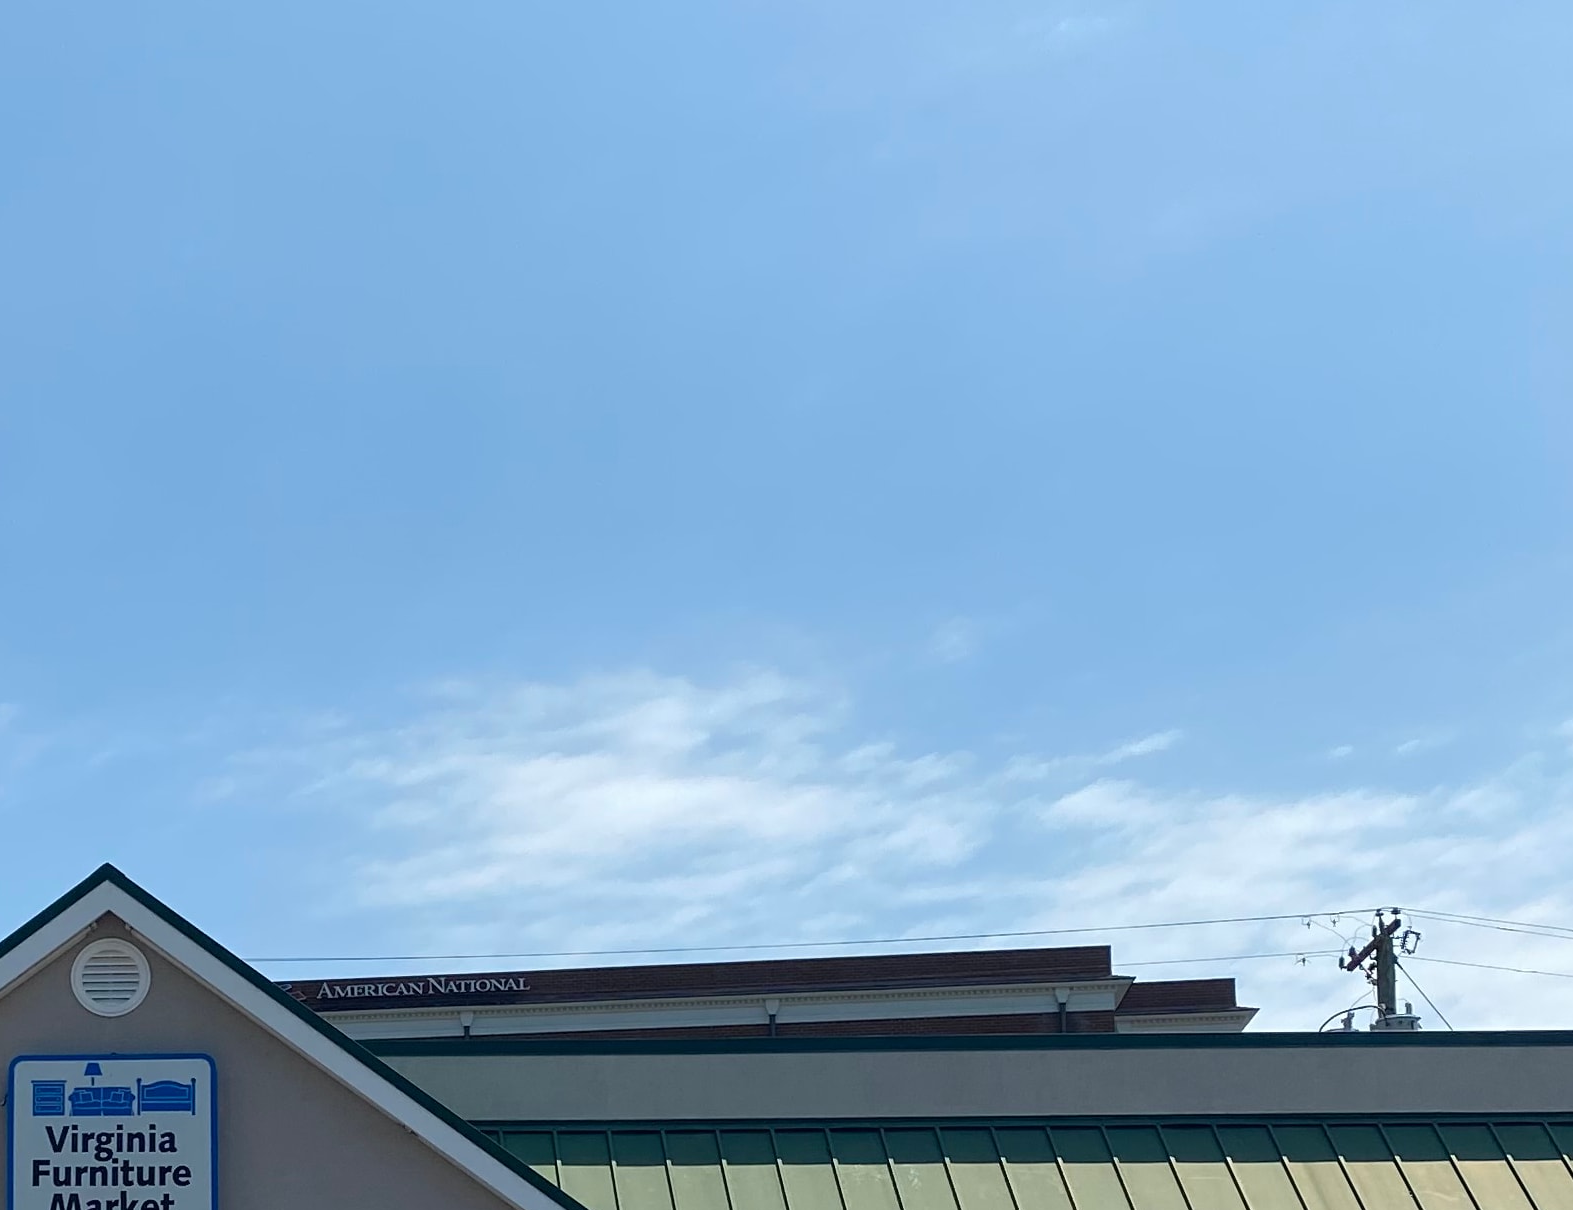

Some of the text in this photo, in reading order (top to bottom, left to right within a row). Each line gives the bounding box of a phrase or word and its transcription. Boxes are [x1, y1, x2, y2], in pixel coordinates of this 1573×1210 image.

[316, 976, 531, 1000] AMERICAN NATIONAL
[45, 1123, 178, 1162] Virginia
[31, 1157, 193, 1188] Furniture
